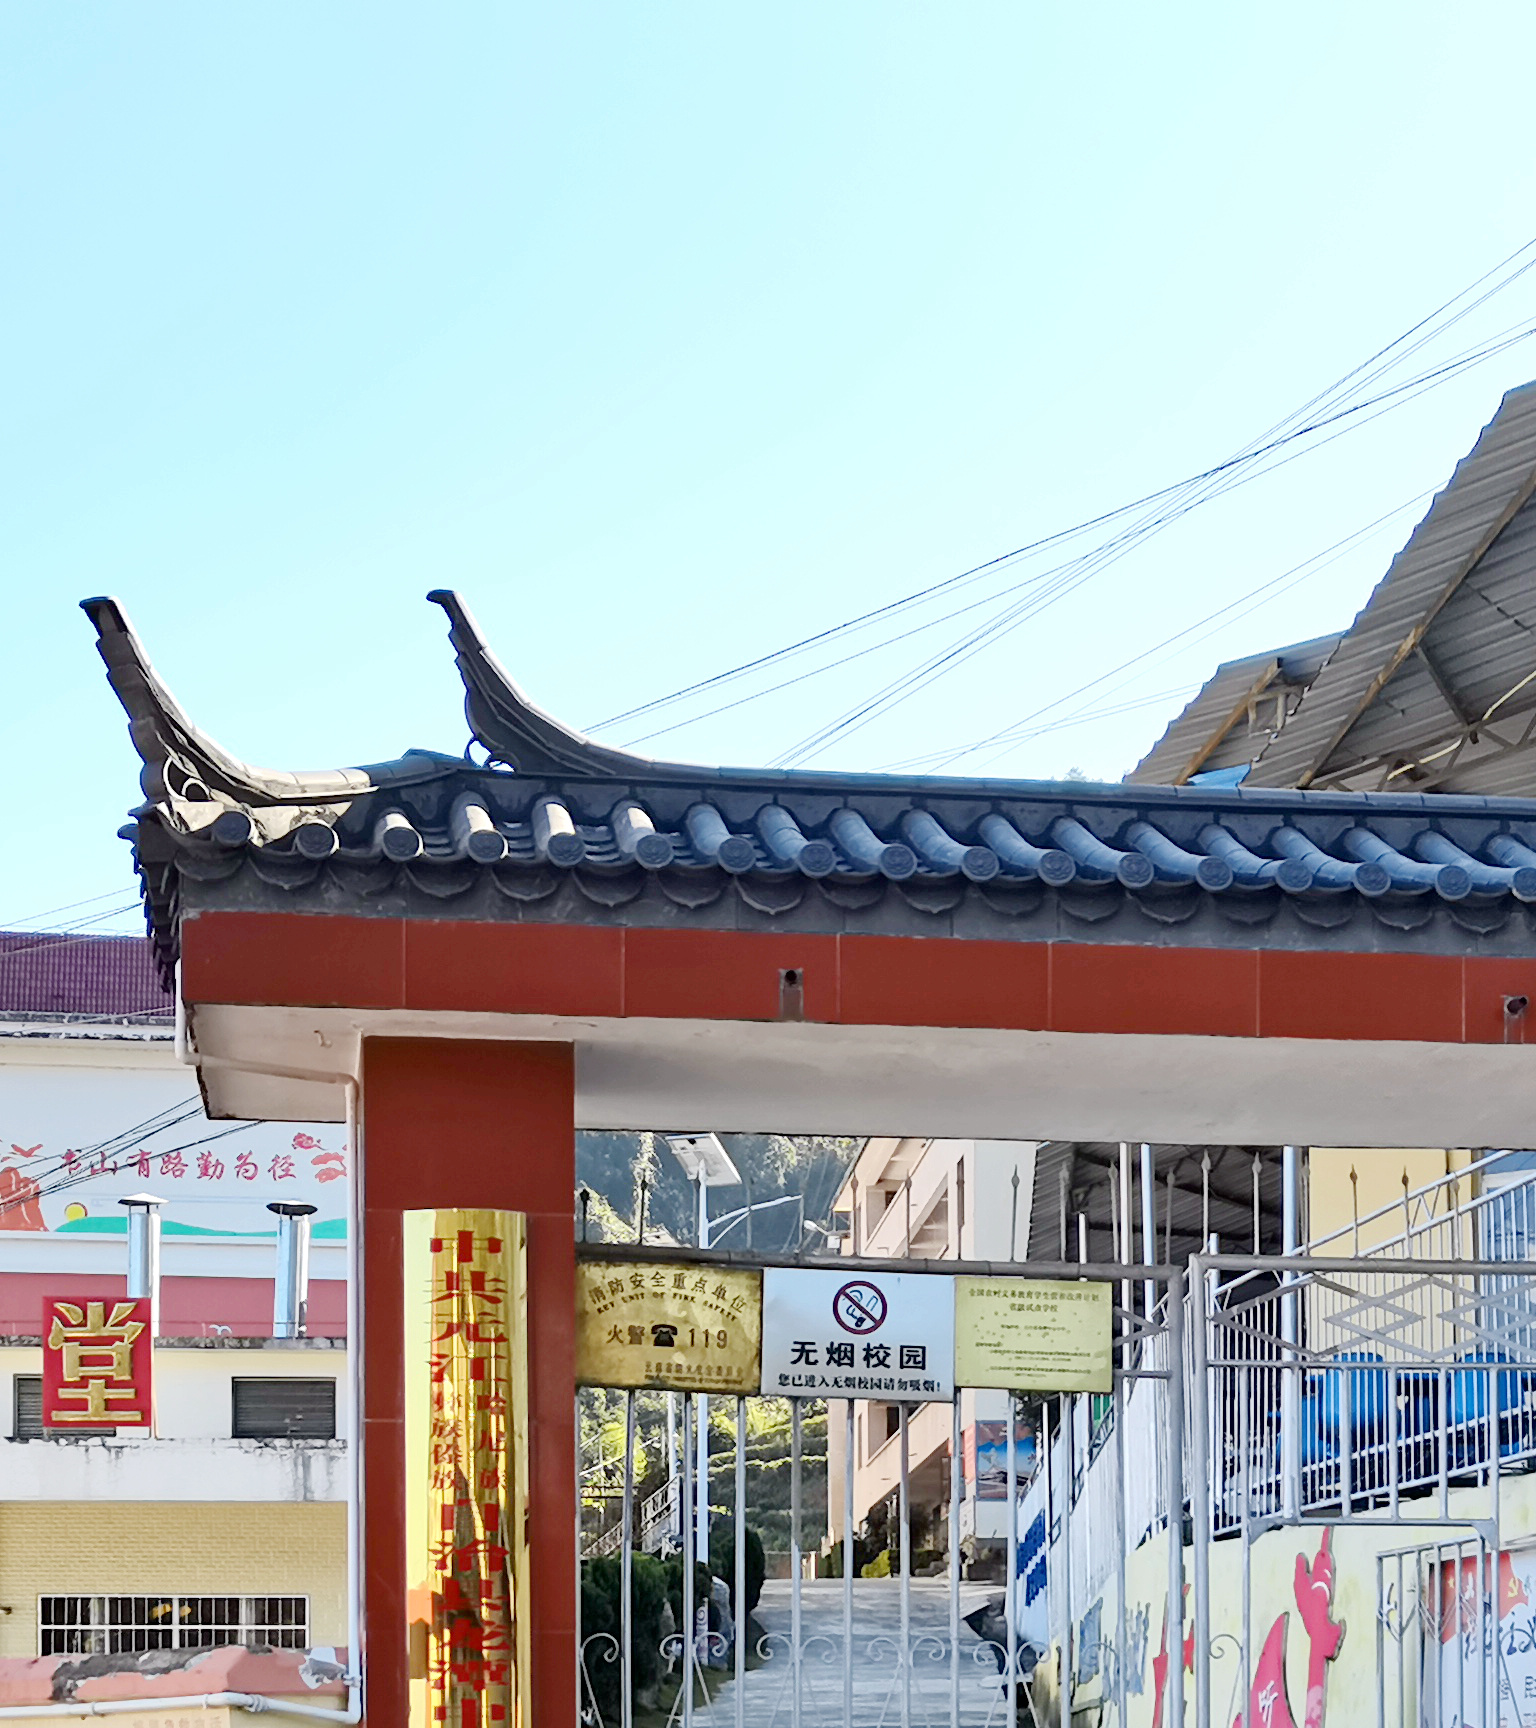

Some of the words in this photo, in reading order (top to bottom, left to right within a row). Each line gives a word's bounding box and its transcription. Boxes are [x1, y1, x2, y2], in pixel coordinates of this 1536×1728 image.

[588, 1271, 747, 1314] 消防安全重点单位
[606, 1324, 646, 1346] 火警
[688, 1327, 728, 1350] 119
[790, 1340, 927, 1371] 无烟校园
[48, 1300, 147, 1424] 堂
